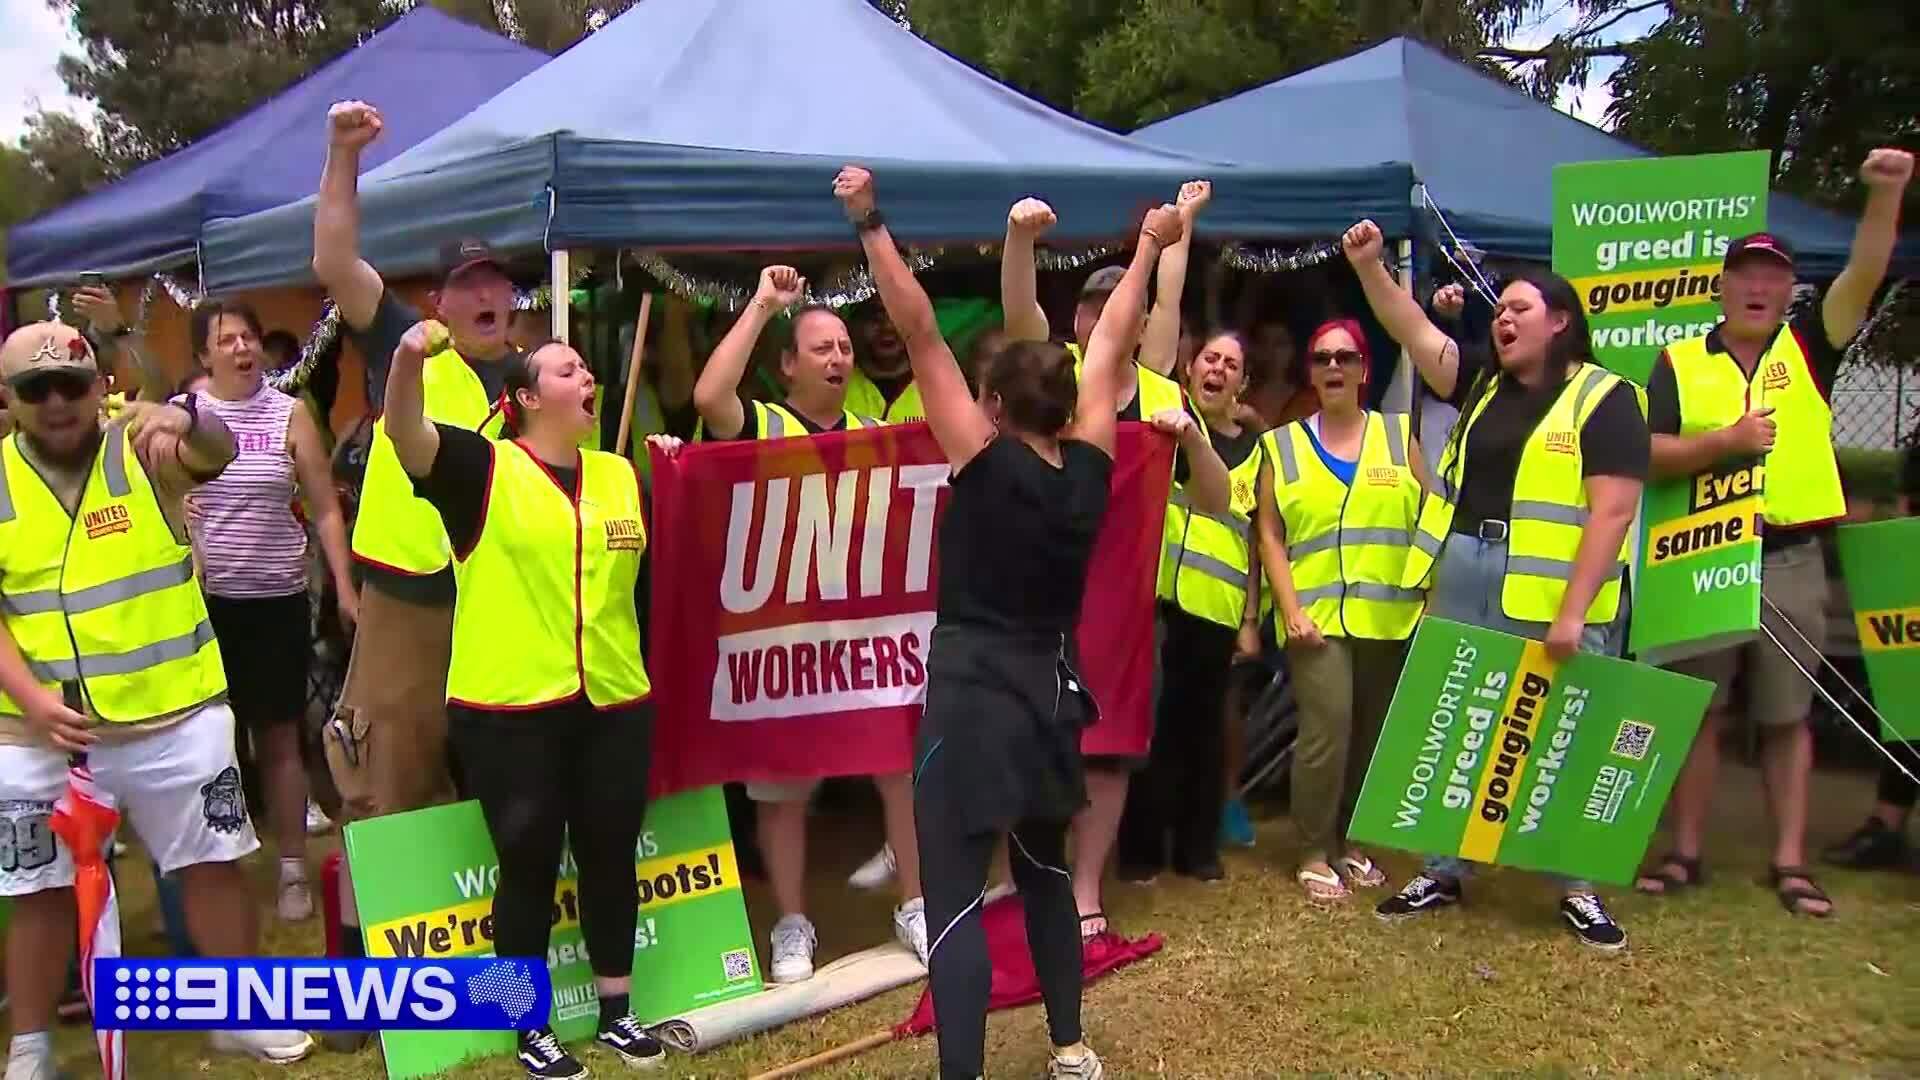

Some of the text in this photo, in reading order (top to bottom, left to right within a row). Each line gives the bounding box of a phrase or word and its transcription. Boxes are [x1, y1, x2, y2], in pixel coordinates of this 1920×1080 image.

[1596, 230, 1729, 271] greed is
[83, 504, 128, 528] UNITED
[720, 463, 952, 614] UNIT
[1654, 516, 1743, 561] same
[728, 631, 925, 704] WORKERS
[1443, 671, 1508, 809] greed is
[1481, 672, 1552, 823] gouging
[1517, 685, 1589, 833] workers!
[1583, 765, 1618, 820] UNITED
